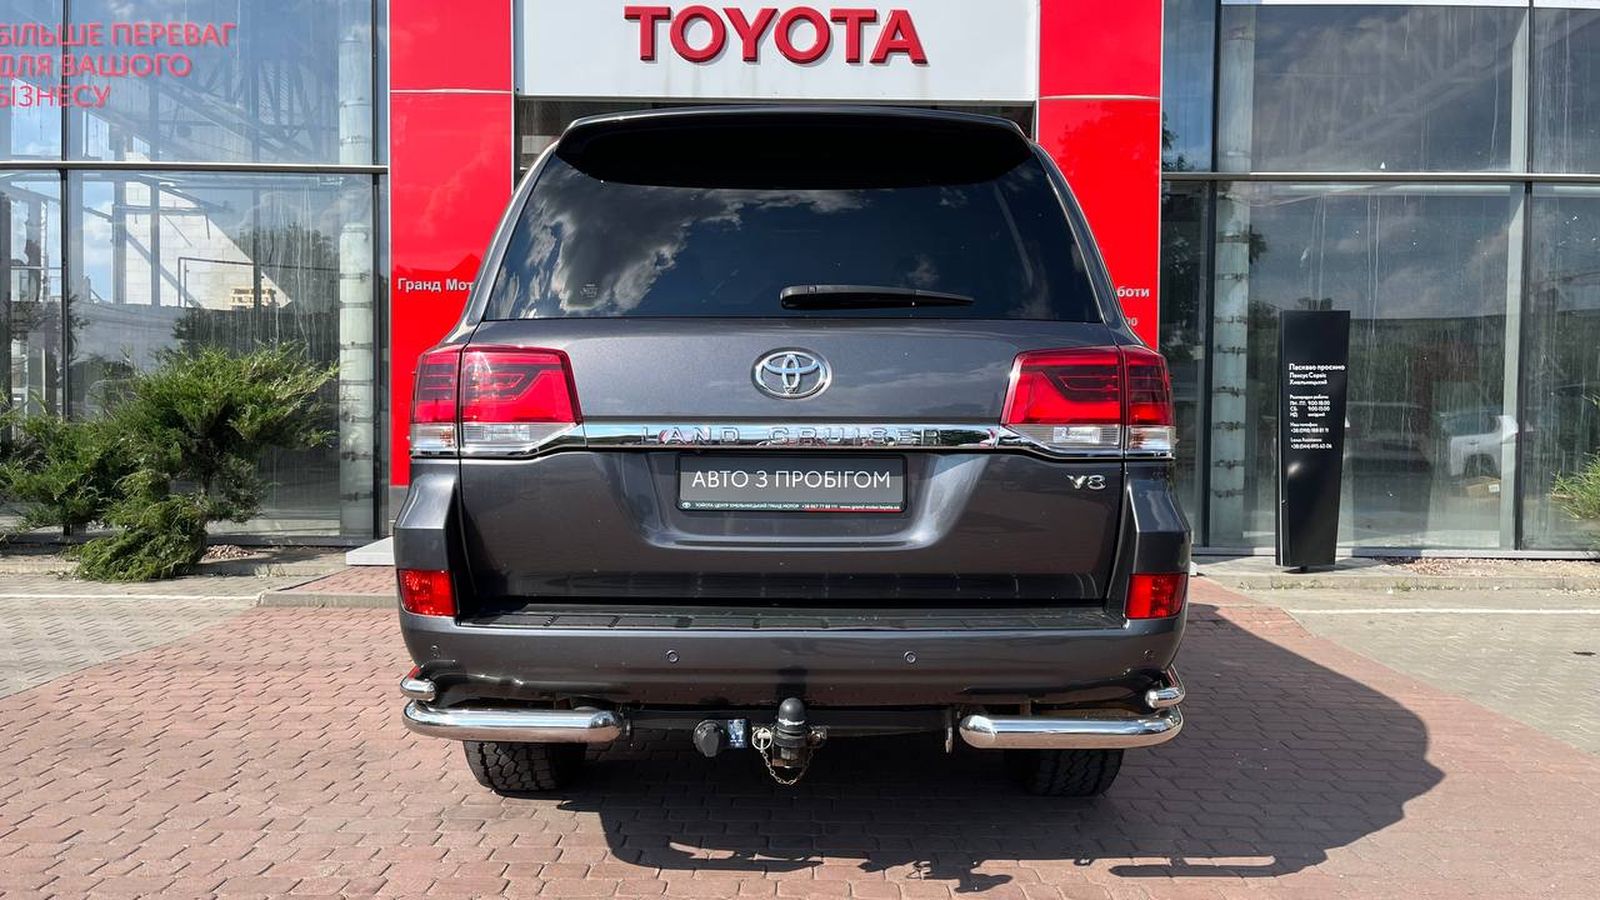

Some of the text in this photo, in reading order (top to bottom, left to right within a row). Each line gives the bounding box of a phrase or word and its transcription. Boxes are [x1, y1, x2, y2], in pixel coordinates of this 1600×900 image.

[0, 22, 237, 47] БІЛЬШЕ ПЕРЕВАГ
[624, 5, 928, 64] TOYOTA
[0, 53, 193, 78] ДЛЯ ВАШОГО
[397, 278, 442, 293] Гранд
[640, 426, 942, 446] LAND CRUISER
[692, 470, 891, 489] АВТО З ПРОБІГОМ
[1066, 474, 1107, 490] V8
